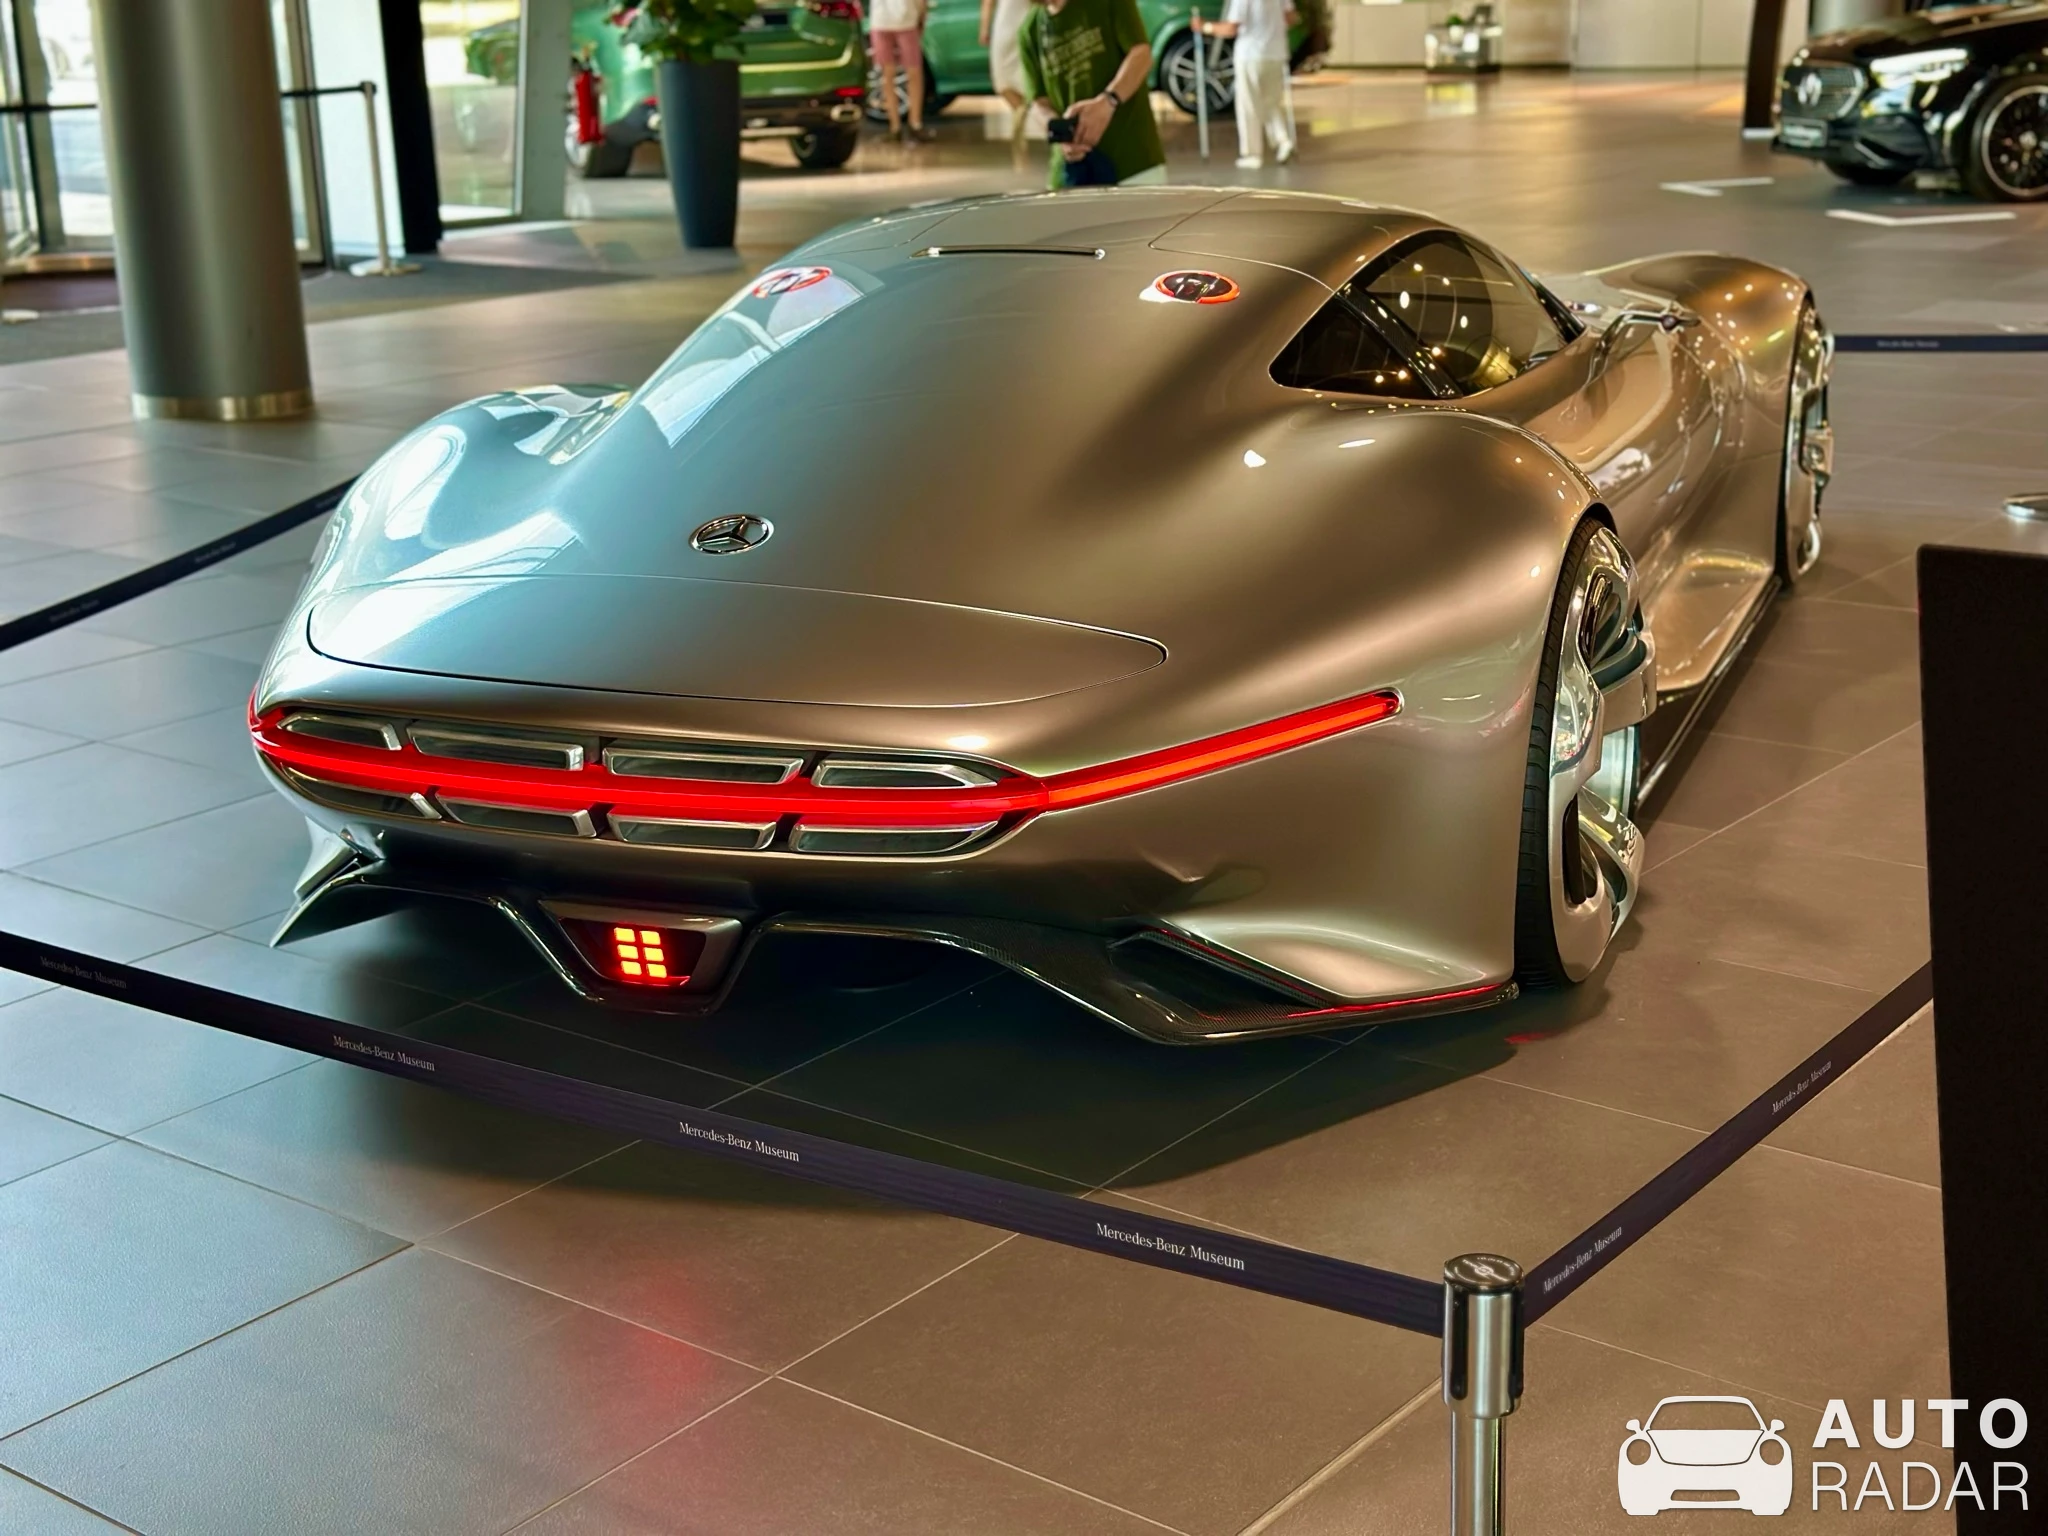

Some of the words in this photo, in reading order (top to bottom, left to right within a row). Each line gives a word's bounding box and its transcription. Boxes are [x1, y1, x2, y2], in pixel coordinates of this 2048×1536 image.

[333, 1035, 395, 1061] Mercedes-Benz
[397, 1051, 436, 1071] Museum
[679, 1122, 752, 1150] Mercedes-Benz
[755, 1140, 800, 1162] Museum
[1096, 1222, 1186, 1257] Mercedes-Benz
[1189, 1244, 1245, 1270] Museum
[1543, 1249, 1593, 1294] Mercedes-Benz
[1594, 1226, 1622, 1255] Museum
